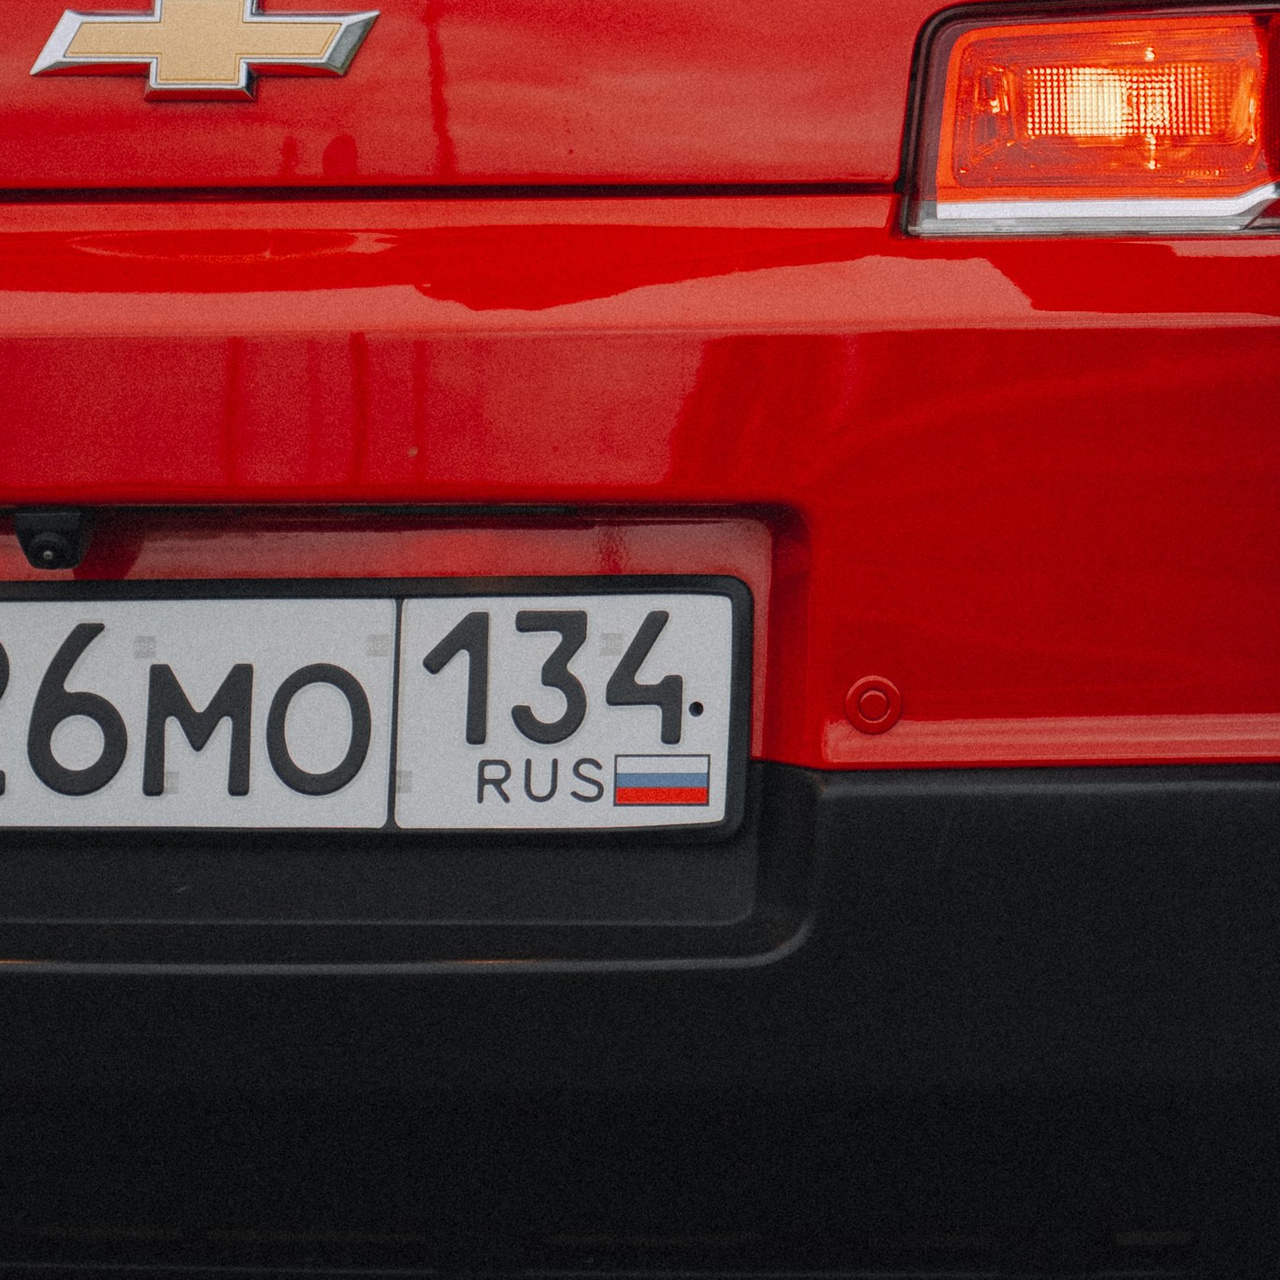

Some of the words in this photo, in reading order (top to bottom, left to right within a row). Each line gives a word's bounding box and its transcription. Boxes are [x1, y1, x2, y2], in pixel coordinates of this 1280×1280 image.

[0, 622, 372, 797] 6MO
[424, 610, 683, 745] 134
[477, 757, 604, 804] RUS
